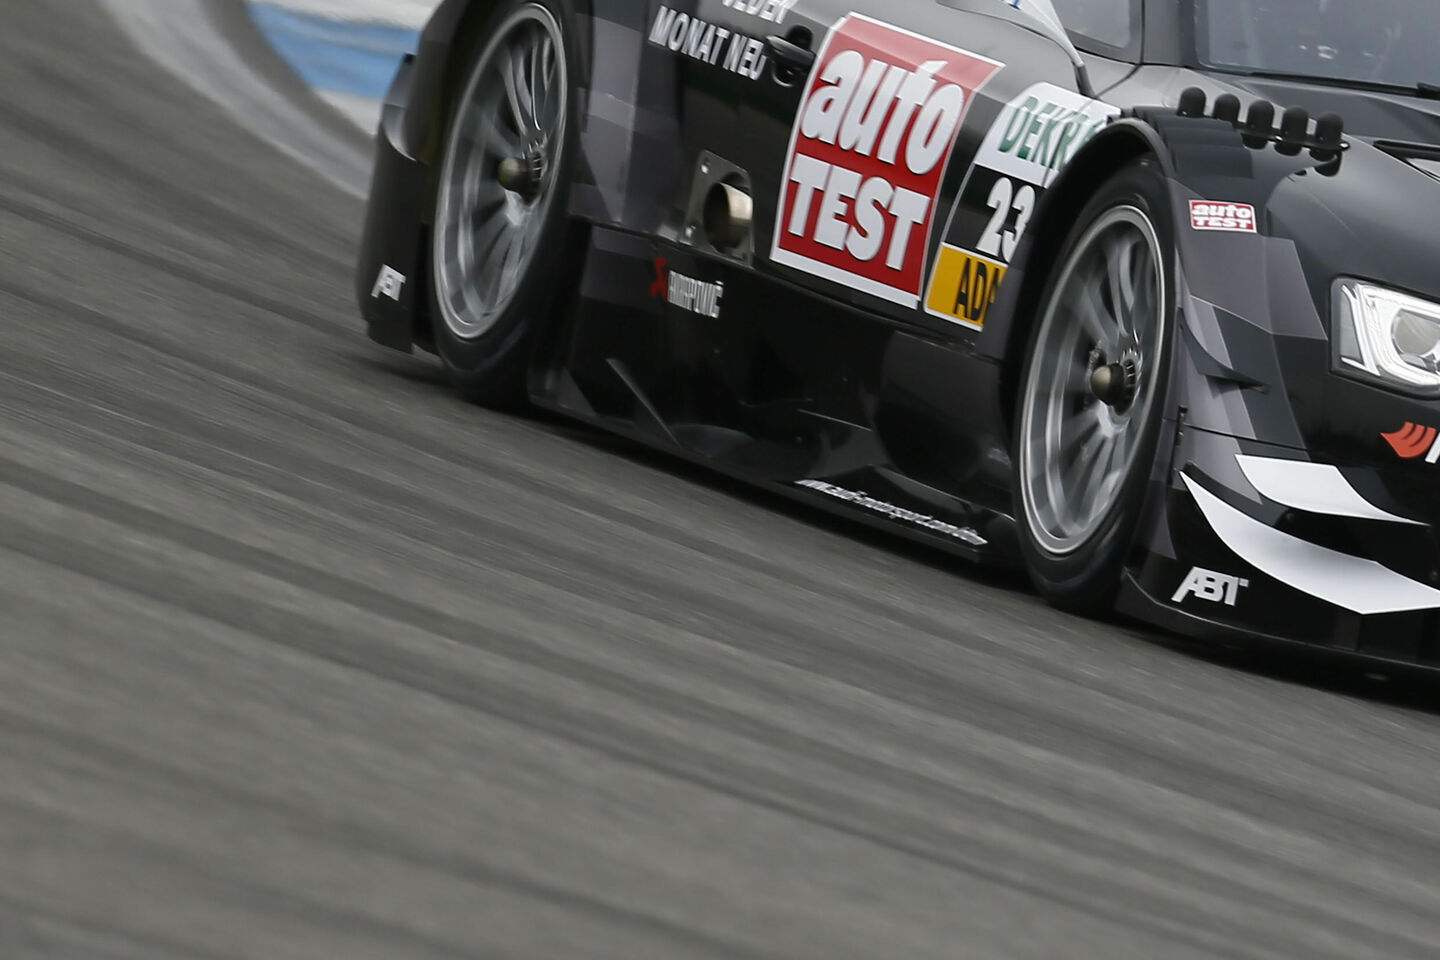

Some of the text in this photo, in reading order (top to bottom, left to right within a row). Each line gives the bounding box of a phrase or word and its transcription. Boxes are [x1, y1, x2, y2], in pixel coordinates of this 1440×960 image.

[648, 5, 768, 81] MONAT NEU
[800, 49, 965, 175] auto
[788, 153, 931, 271] TEST
[975, 177, 1035, 263] 23
[1191, 204, 1252, 219] auto
[1193, 216, 1252, 229] TEST
[1171, 566, 1249, 607] ABT
